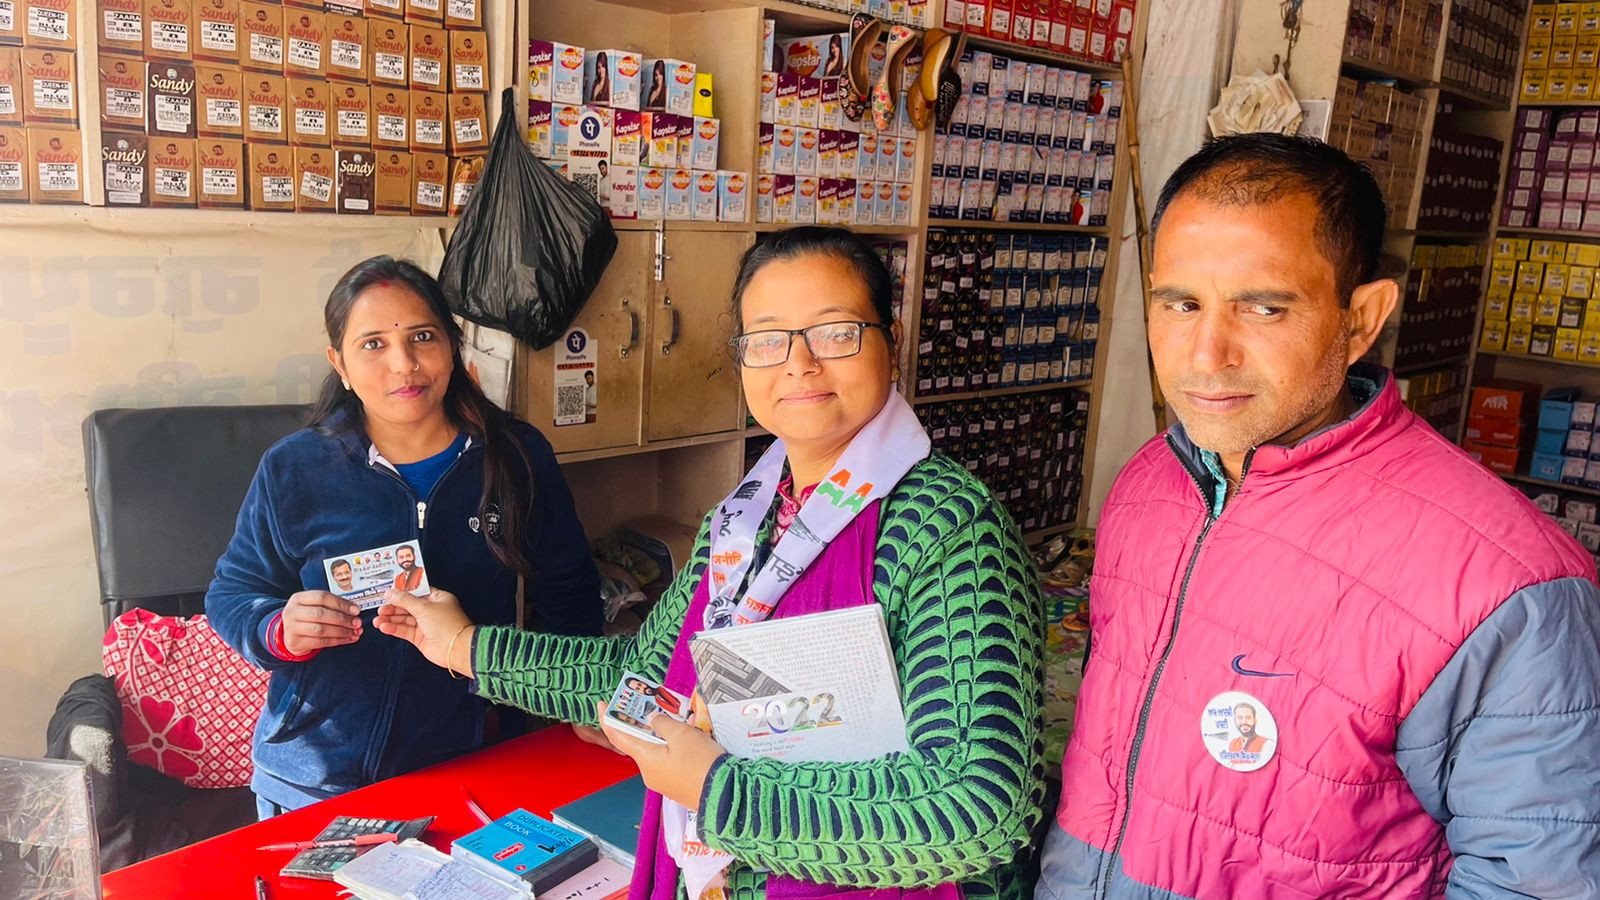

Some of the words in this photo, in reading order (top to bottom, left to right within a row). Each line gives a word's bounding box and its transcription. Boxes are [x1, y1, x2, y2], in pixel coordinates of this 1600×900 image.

[113, 12, 141, 22] ZAARA
[149, 5, 188, 23] Sandy
[200, 6, 238, 23] Sandy
[160, 24, 186, 34] ZAARA
[210, 23, 235, 33] ZAARA
[243, 18, 279, 36] Sandy
[288, 24, 323, 42] Sandy
[375, 37, 405, 53] Sandy
[413, 42, 443, 58] Sandy
[455, 47, 483, 60] Sandy
[787, 53, 821, 71] Kapstar
[28, 63, 70, 79] Sandy
[101, 75, 141, 89] Sandy
[150, 74, 194, 95] Sandy
[201, 84, 238, 99] Sandy
[248, 90, 282, 106] Sandy
[293, 96, 327, 110] Sandy
[334, 97, 366, 110] Sandy
[376, 102, 406, 117] Sandy
[415, 105, 443, 119] Sandy
[454, 105, 482, 118] Sandy
[615, 121, 640, 135] Kapstar
[653, 123, 677, 138] Kapstar
[0, 148, 24, 163] ndy
[37, 149, 78, 163] Sandy
[101, 146, 147, 166] Sandy
[154, 154, 191, 169] Sandy
[200, 154, 237, 169] Sandy
[256, 162, 290, 176] Sandy
[299, 162, 330, 176] Sandy
[340, 159, 375, 177] Sandy
[380, 162, 409, 178] Sandy
[416, 167, 444, 181] Sandy
[612, 181, 636, 193] Kapstar
[741, 692, 843, 738] 2022
[504, 820, 531, 837] BOOK
[516, 814, 567, 841] DUPLICATE
